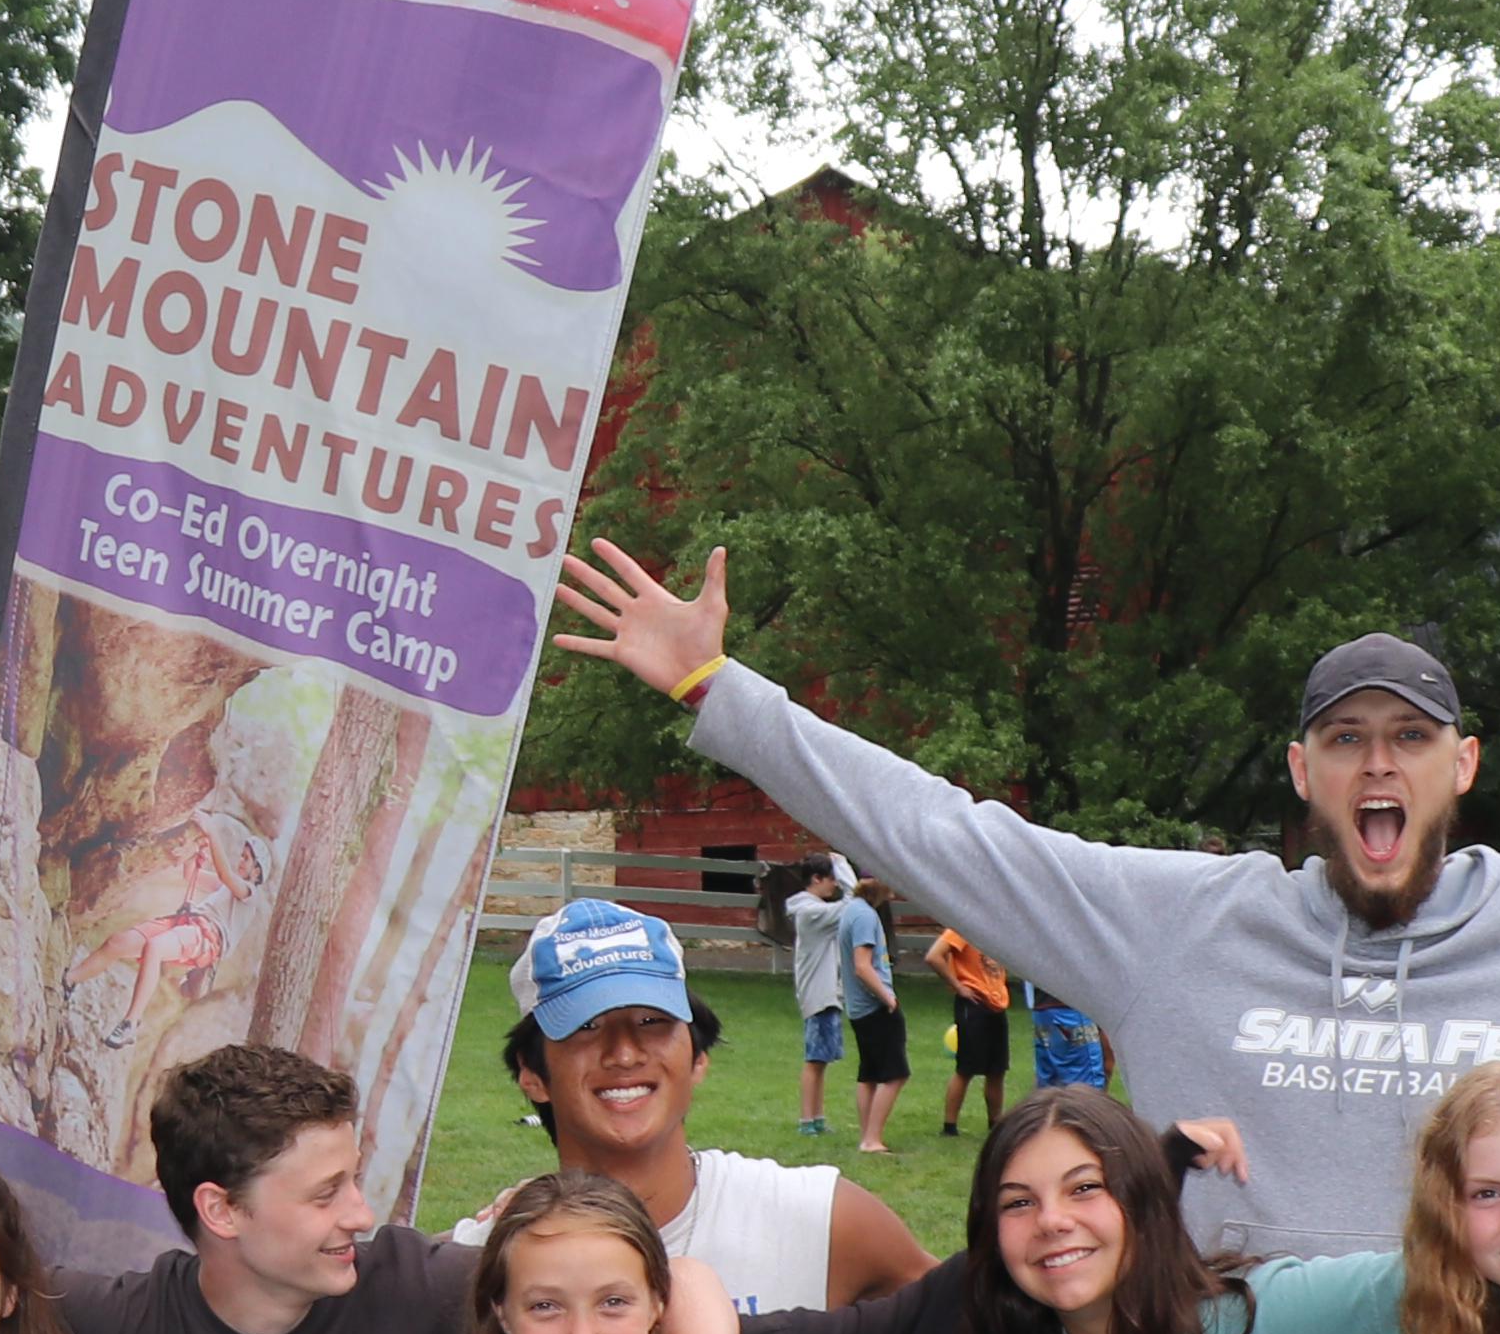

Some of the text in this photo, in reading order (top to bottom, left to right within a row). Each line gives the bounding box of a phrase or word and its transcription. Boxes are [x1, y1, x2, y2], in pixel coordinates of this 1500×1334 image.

[83, 151, 370, 305] STONE
[62, 244, 590, 473] MOUNTAIN
[43, 350, 566, 559] ADVENTURES
[79, 517, 460, 691] Teen Summer Camp
[104, 472, 438, 619] Co-Ed Overnight
[553, 919, 644, 943] Stone Mountain
[561, 949, 655, 978] Adventures
[1232, 1006, 1429, 1065] SANTA
